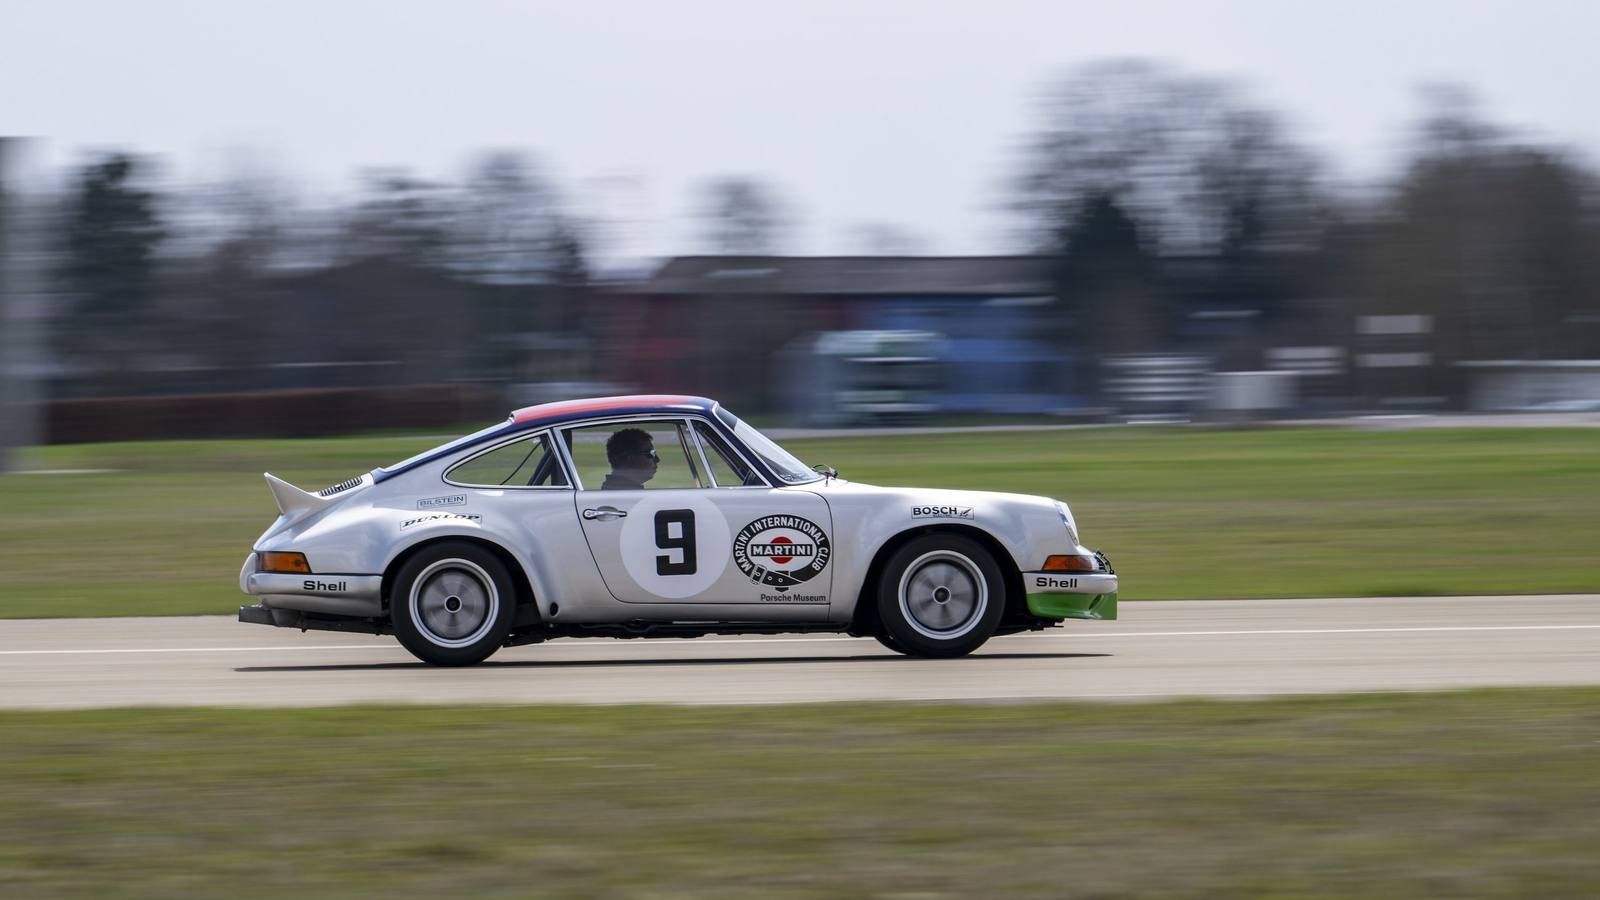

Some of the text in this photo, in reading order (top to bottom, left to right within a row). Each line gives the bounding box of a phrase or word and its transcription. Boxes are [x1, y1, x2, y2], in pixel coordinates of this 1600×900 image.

[420, 496, 464, 506] BILSTEIN
[913, 506, 957, 515] BOSCH
[403, 514, 480, 527] DUNLOP
[654, 509, 697, 576] 9
[735, 516, 829, 572] MARTINI INTERNATIONAL CLUB
[753, 545, 811, 555] MARTINI
[303, 580, 346, 591] Shell
[1036, 577, 1077, 588] Shell
[760, 593, 826, 602] Porsche Museum
